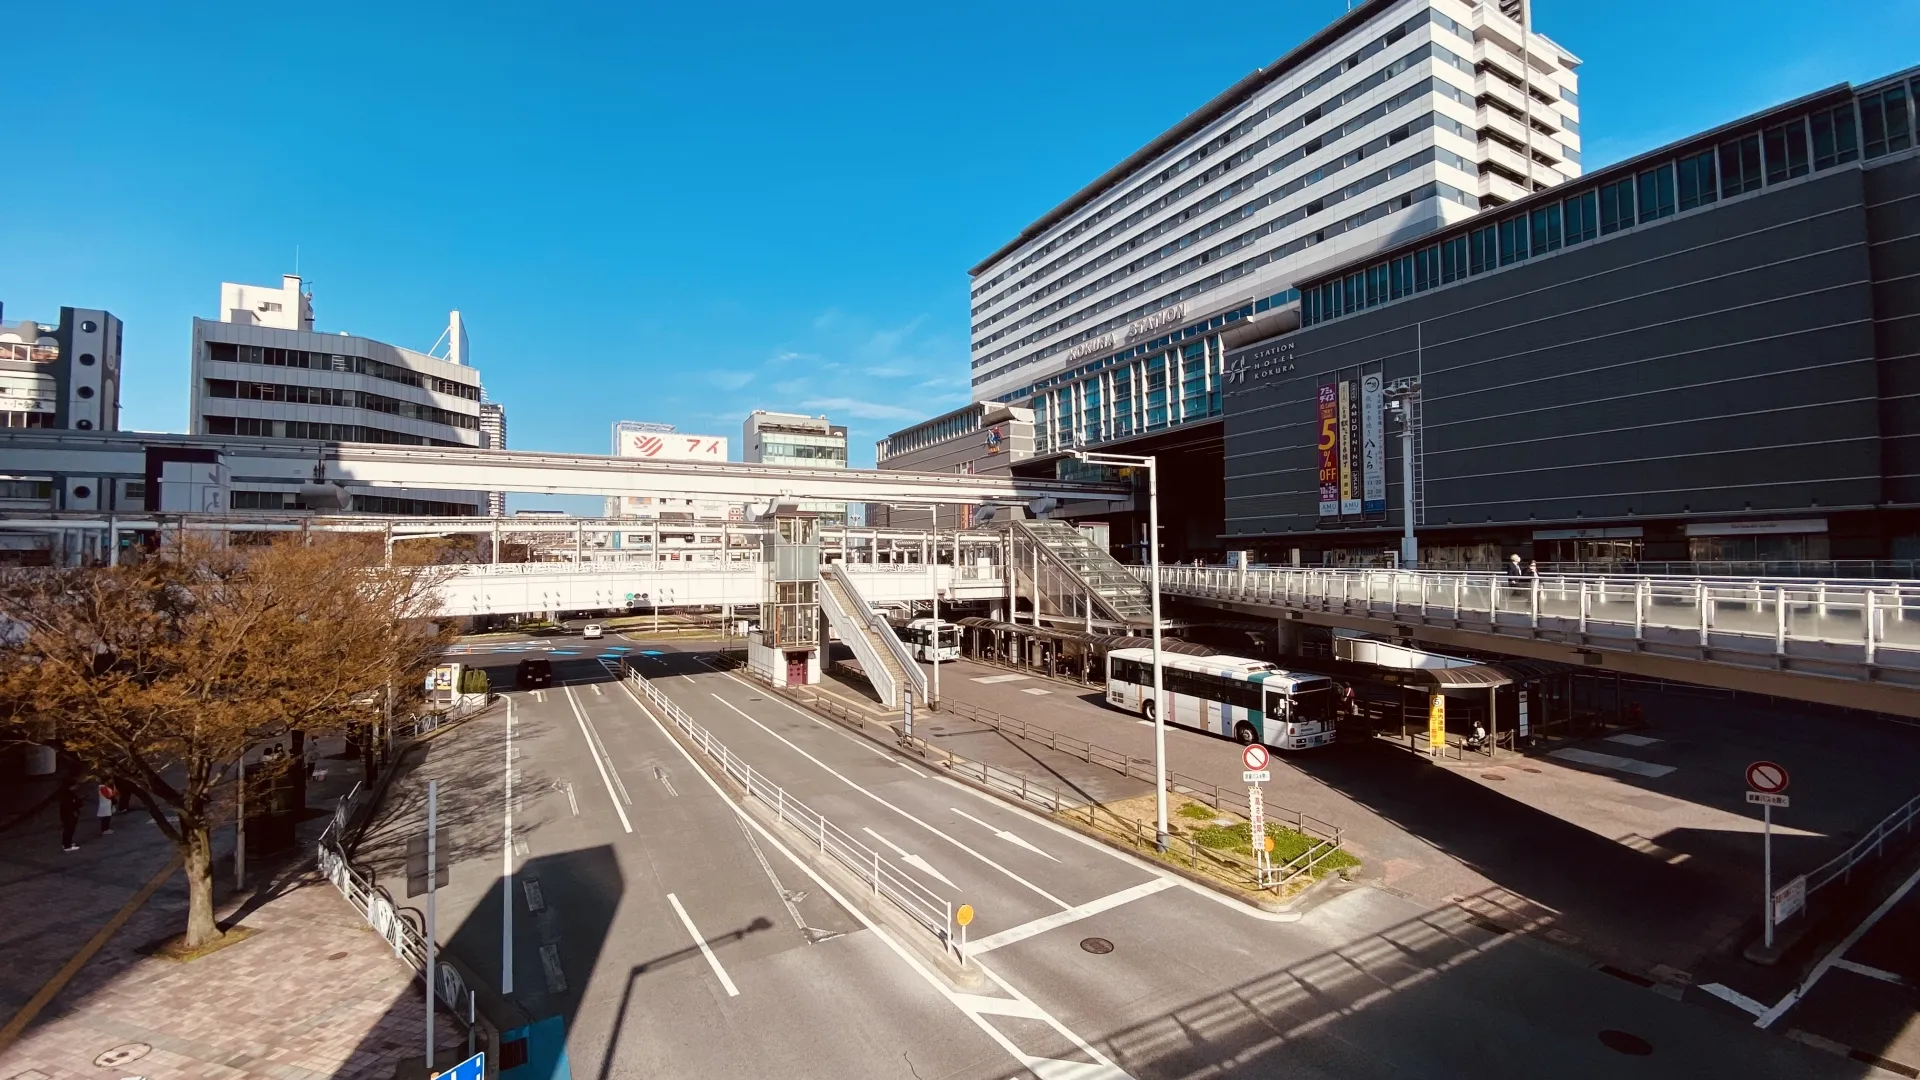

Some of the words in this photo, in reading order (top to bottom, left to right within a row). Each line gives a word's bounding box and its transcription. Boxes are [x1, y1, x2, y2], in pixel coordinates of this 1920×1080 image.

[1069, 332, 1117, 361] KOKURA
[1128, 302, 1188, 337] STATION
[1254, 342, 1295, 360] STATION
[1254, 353, 1294, 370] HOTEL
[1254, 363, 1295, 380] KOKURA
[1318, 418, 1336, 450] 5
[1323, 450, 1332, 468] %
[1320, 468, 1337, 481] OFF
